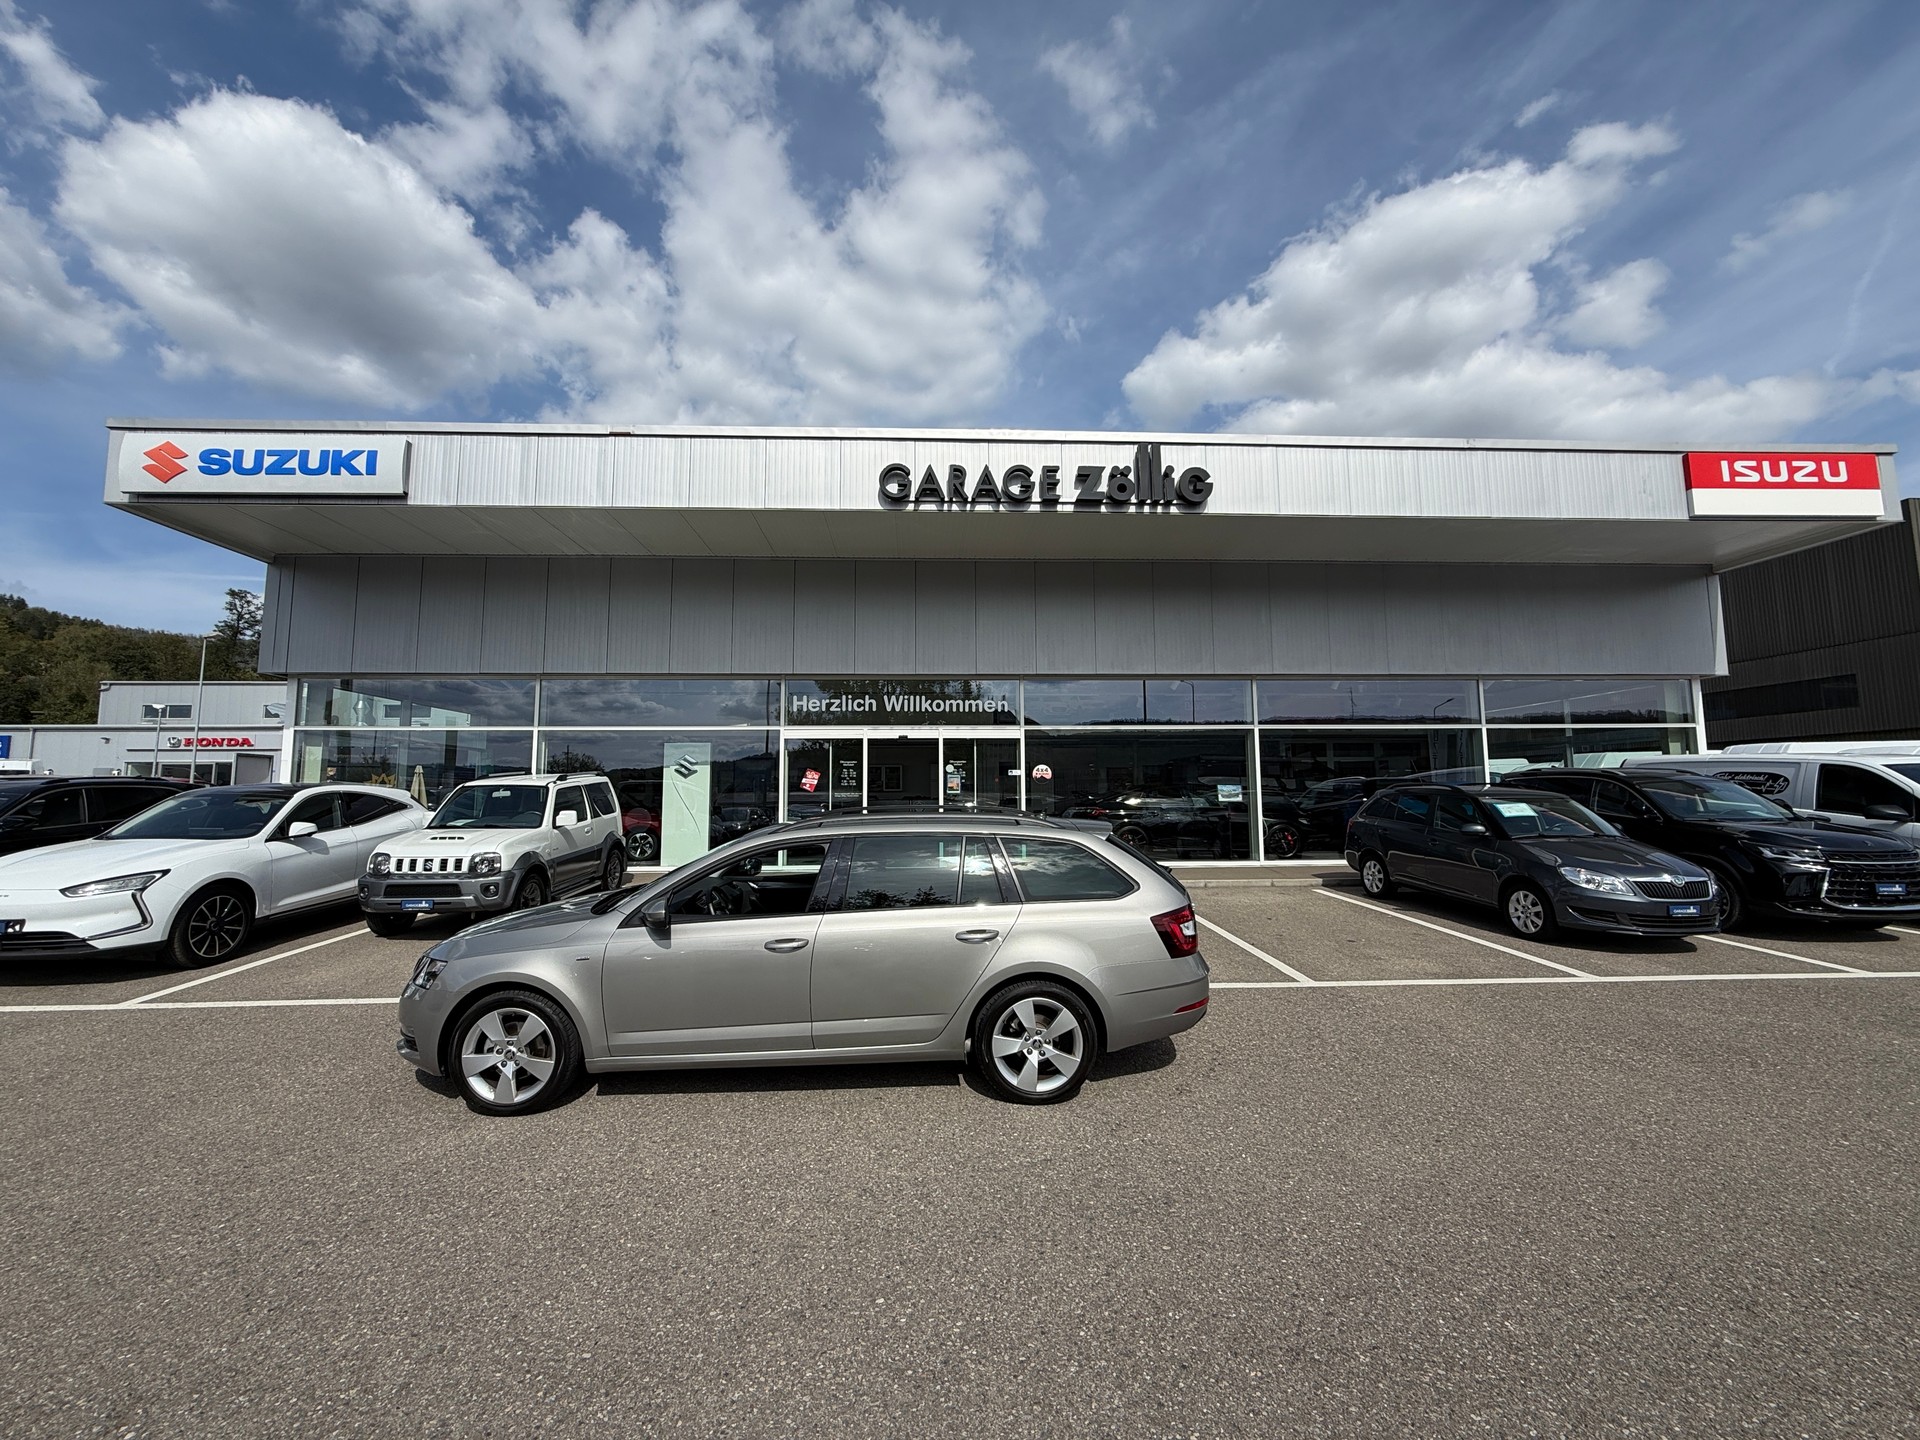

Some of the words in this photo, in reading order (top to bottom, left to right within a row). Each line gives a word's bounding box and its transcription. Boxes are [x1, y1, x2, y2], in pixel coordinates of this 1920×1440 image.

[197, 448, 378, 476] SUZUKI
[1720, 460, 1848, 483] ISUZU
[878, 463, 1060, 501] GARAGE
[792, 694, 877, 712] Herzlich
[883, 694, 1009, 713] Willkommen
[183, 737, 254, 747] HONDA
